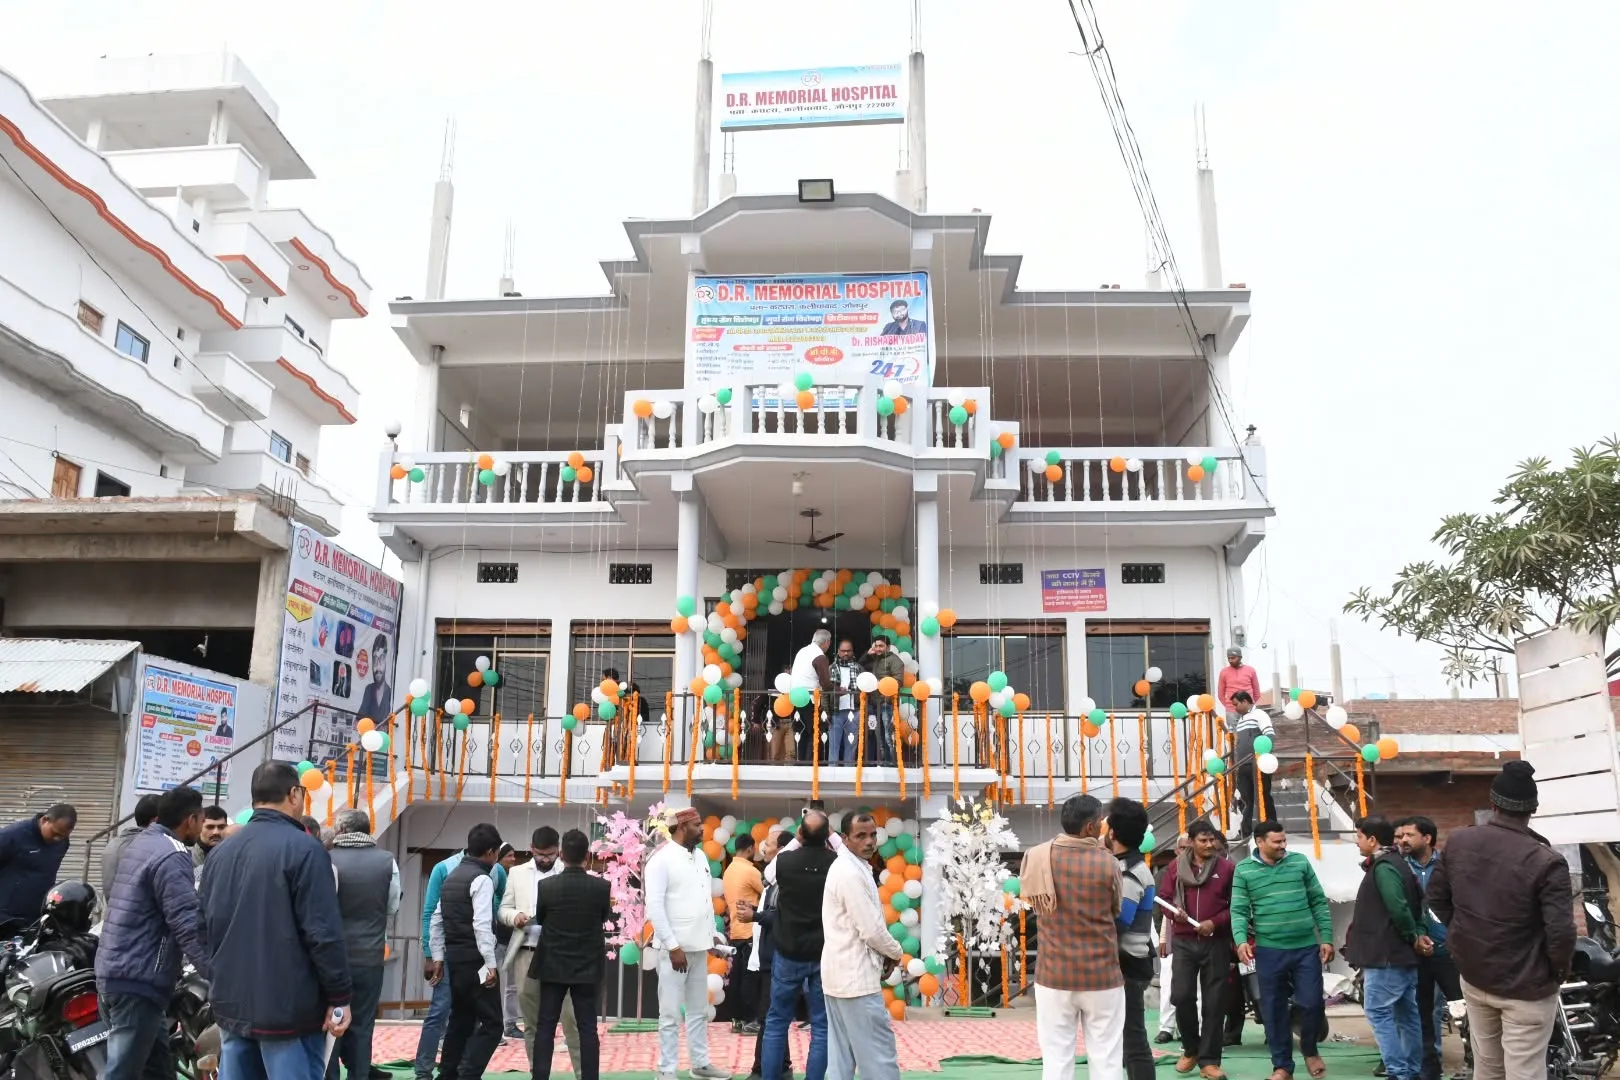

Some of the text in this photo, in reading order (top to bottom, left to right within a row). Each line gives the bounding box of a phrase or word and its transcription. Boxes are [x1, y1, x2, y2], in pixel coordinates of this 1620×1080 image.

[726, 84, 898, 107] D.R. MEMORIAL HOSPITAL
[718, 280, 921, 301] D.R. MEMORIAL HOSPITAL
[851, 333, 926, 347] Dr. RISHABH YADAV
[314, 540, 398, 601] D.R. MEMORIAL HOSPITAL
[172, 680, 205, 701] MEMORIAL
[206, 687, 233, 706] HOSPITAL
